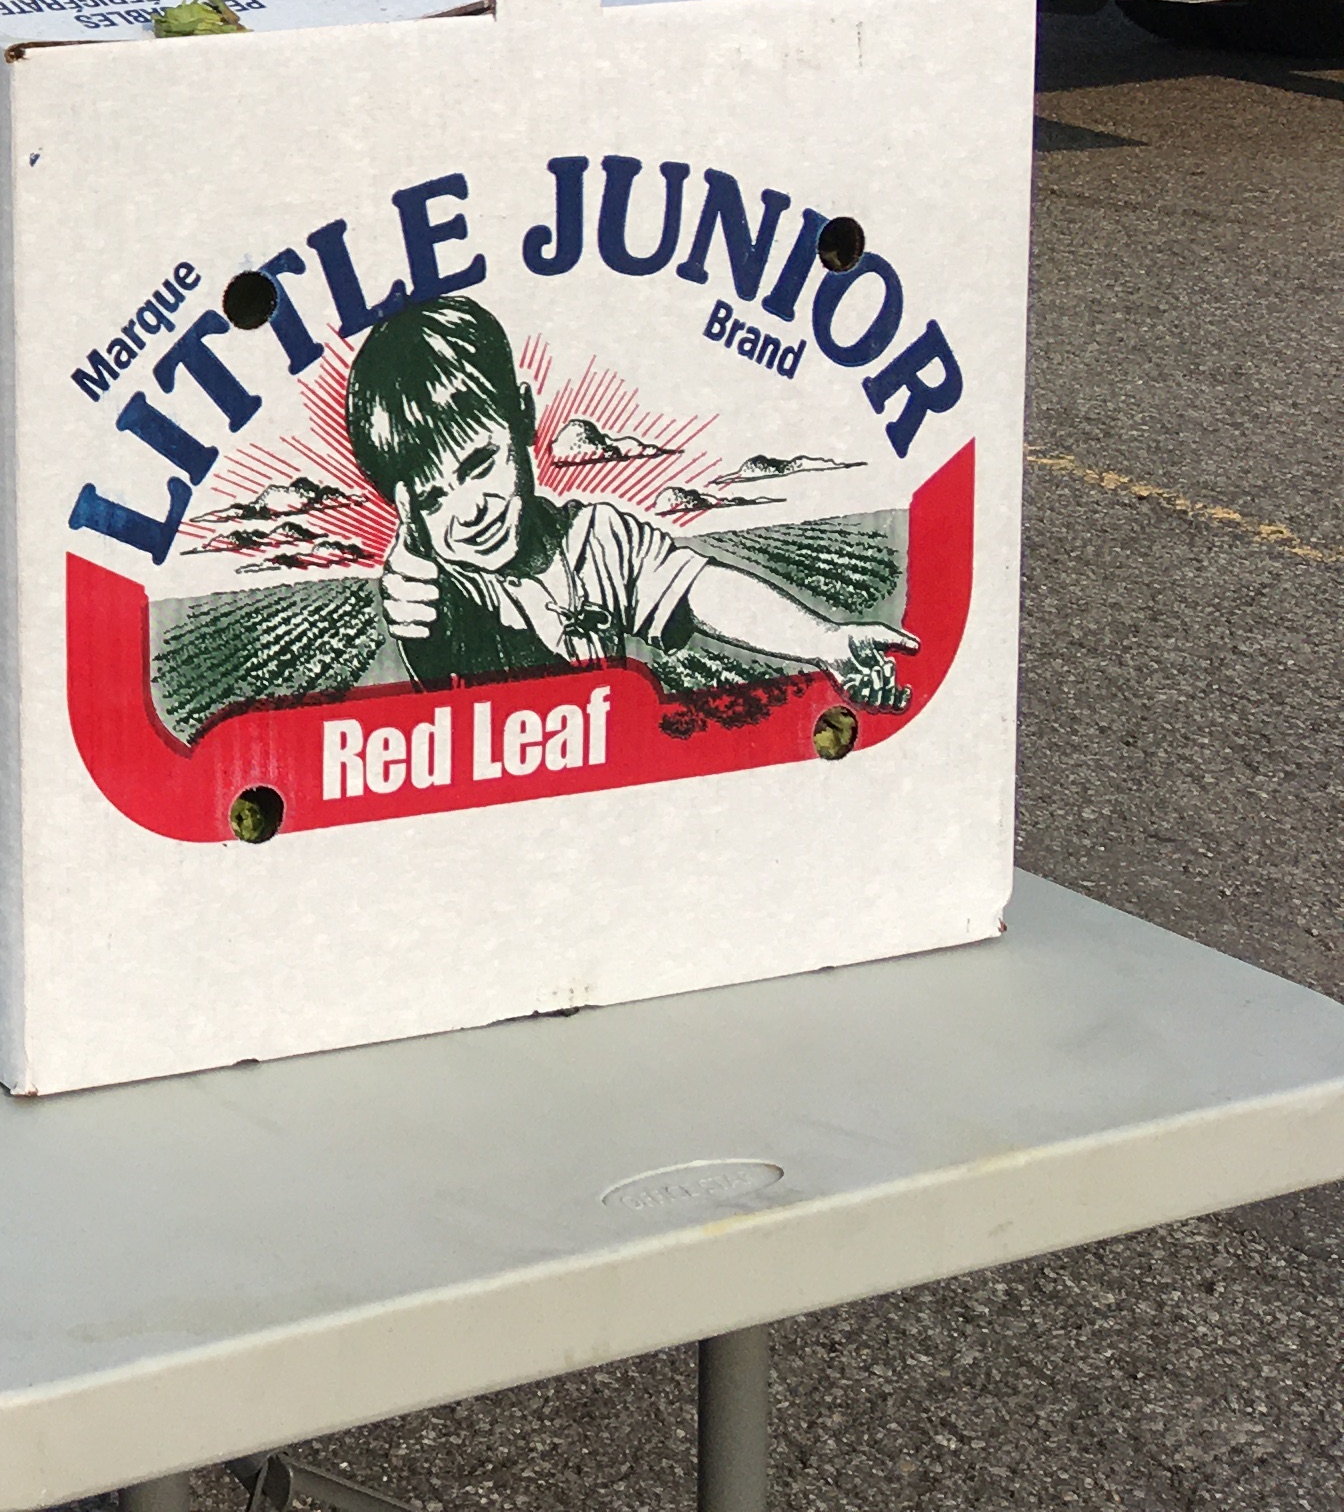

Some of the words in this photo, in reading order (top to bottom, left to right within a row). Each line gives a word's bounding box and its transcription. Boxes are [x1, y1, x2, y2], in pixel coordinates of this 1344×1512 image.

[68, 173, 486, 566] LITTLE
[521, 155, 963, 458] JUNIOR
[71, 262, 201, 402] Marque
[702, 299, 807, 380] Brand
[322, 706, 452, 801] Red
[472, 686, 611, 782] Leaf
